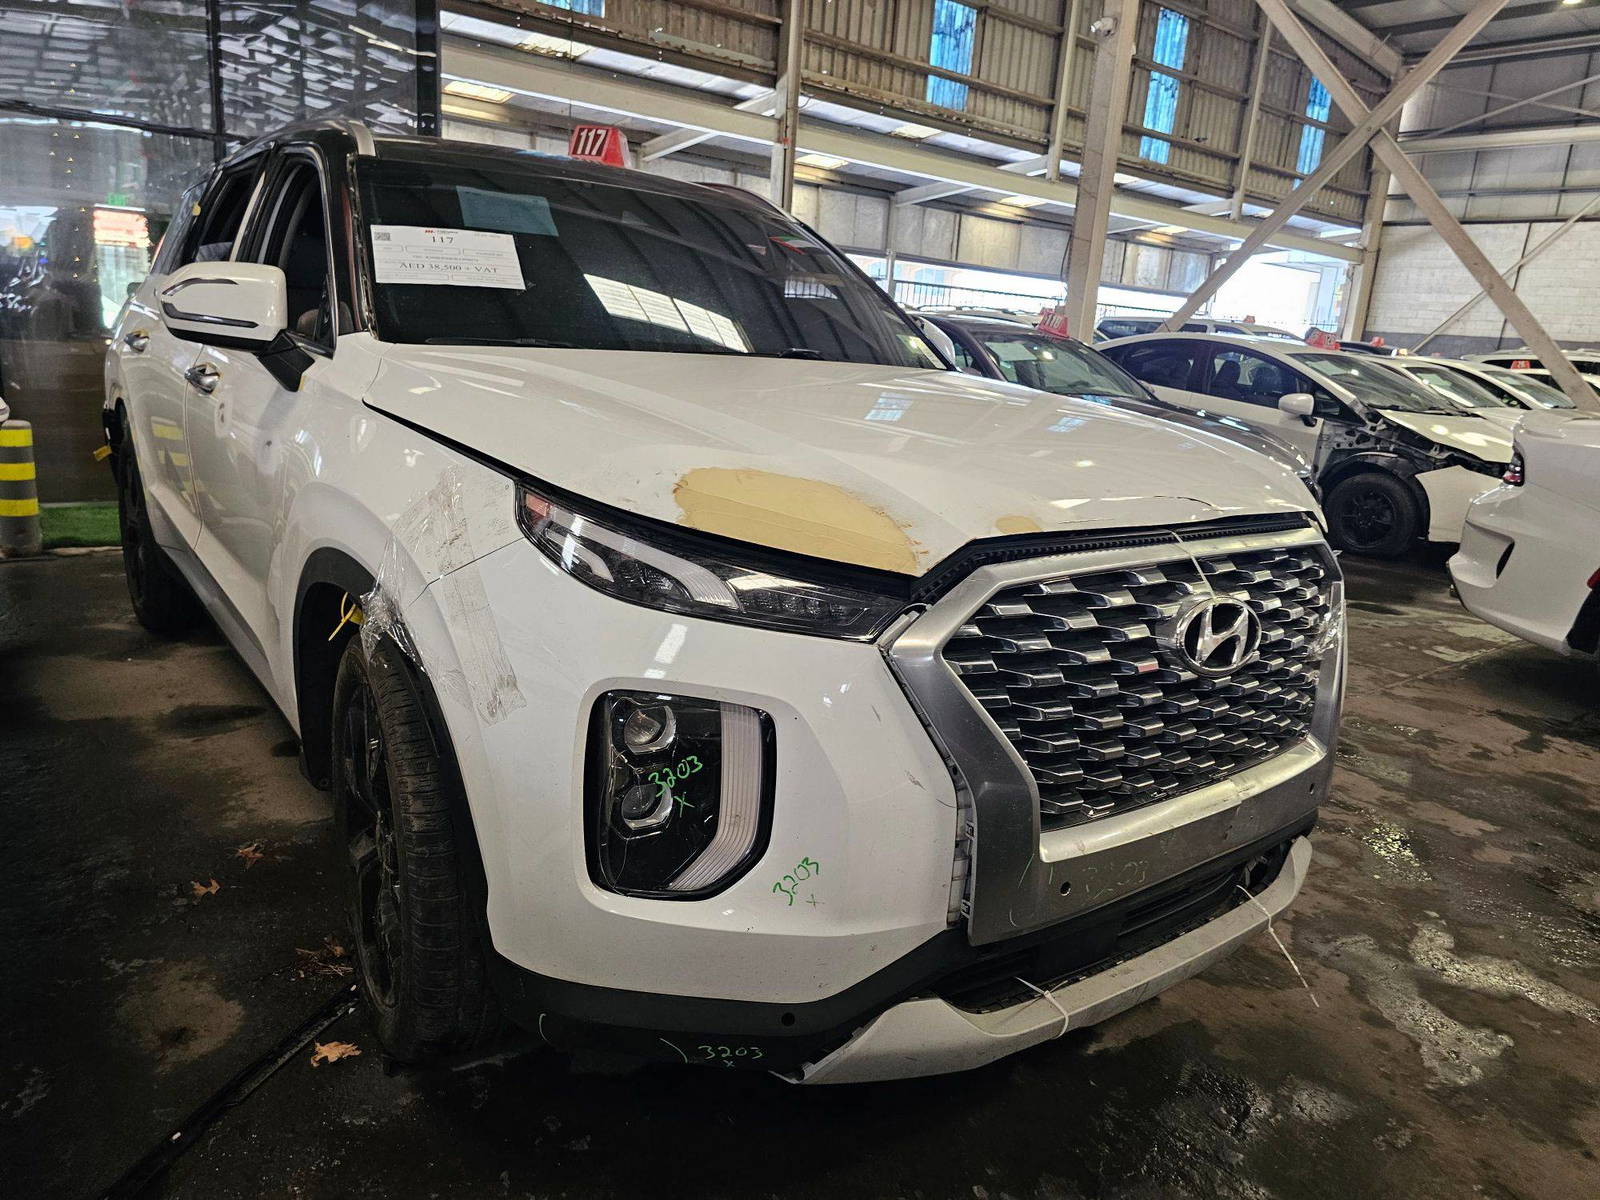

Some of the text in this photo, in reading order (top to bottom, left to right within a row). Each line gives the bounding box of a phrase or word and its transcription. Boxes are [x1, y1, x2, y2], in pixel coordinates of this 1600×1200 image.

[576, 128, 607, 156] 117
[432, 235, 454, 244] 117
[399, 262, 425, 270] AED
[474, 265, 497, 273] VAT
[648, 754, 703, 798] 3203
[772, 857, 819, 906] 3203
[697, 1045, 763, 1060] 3203
